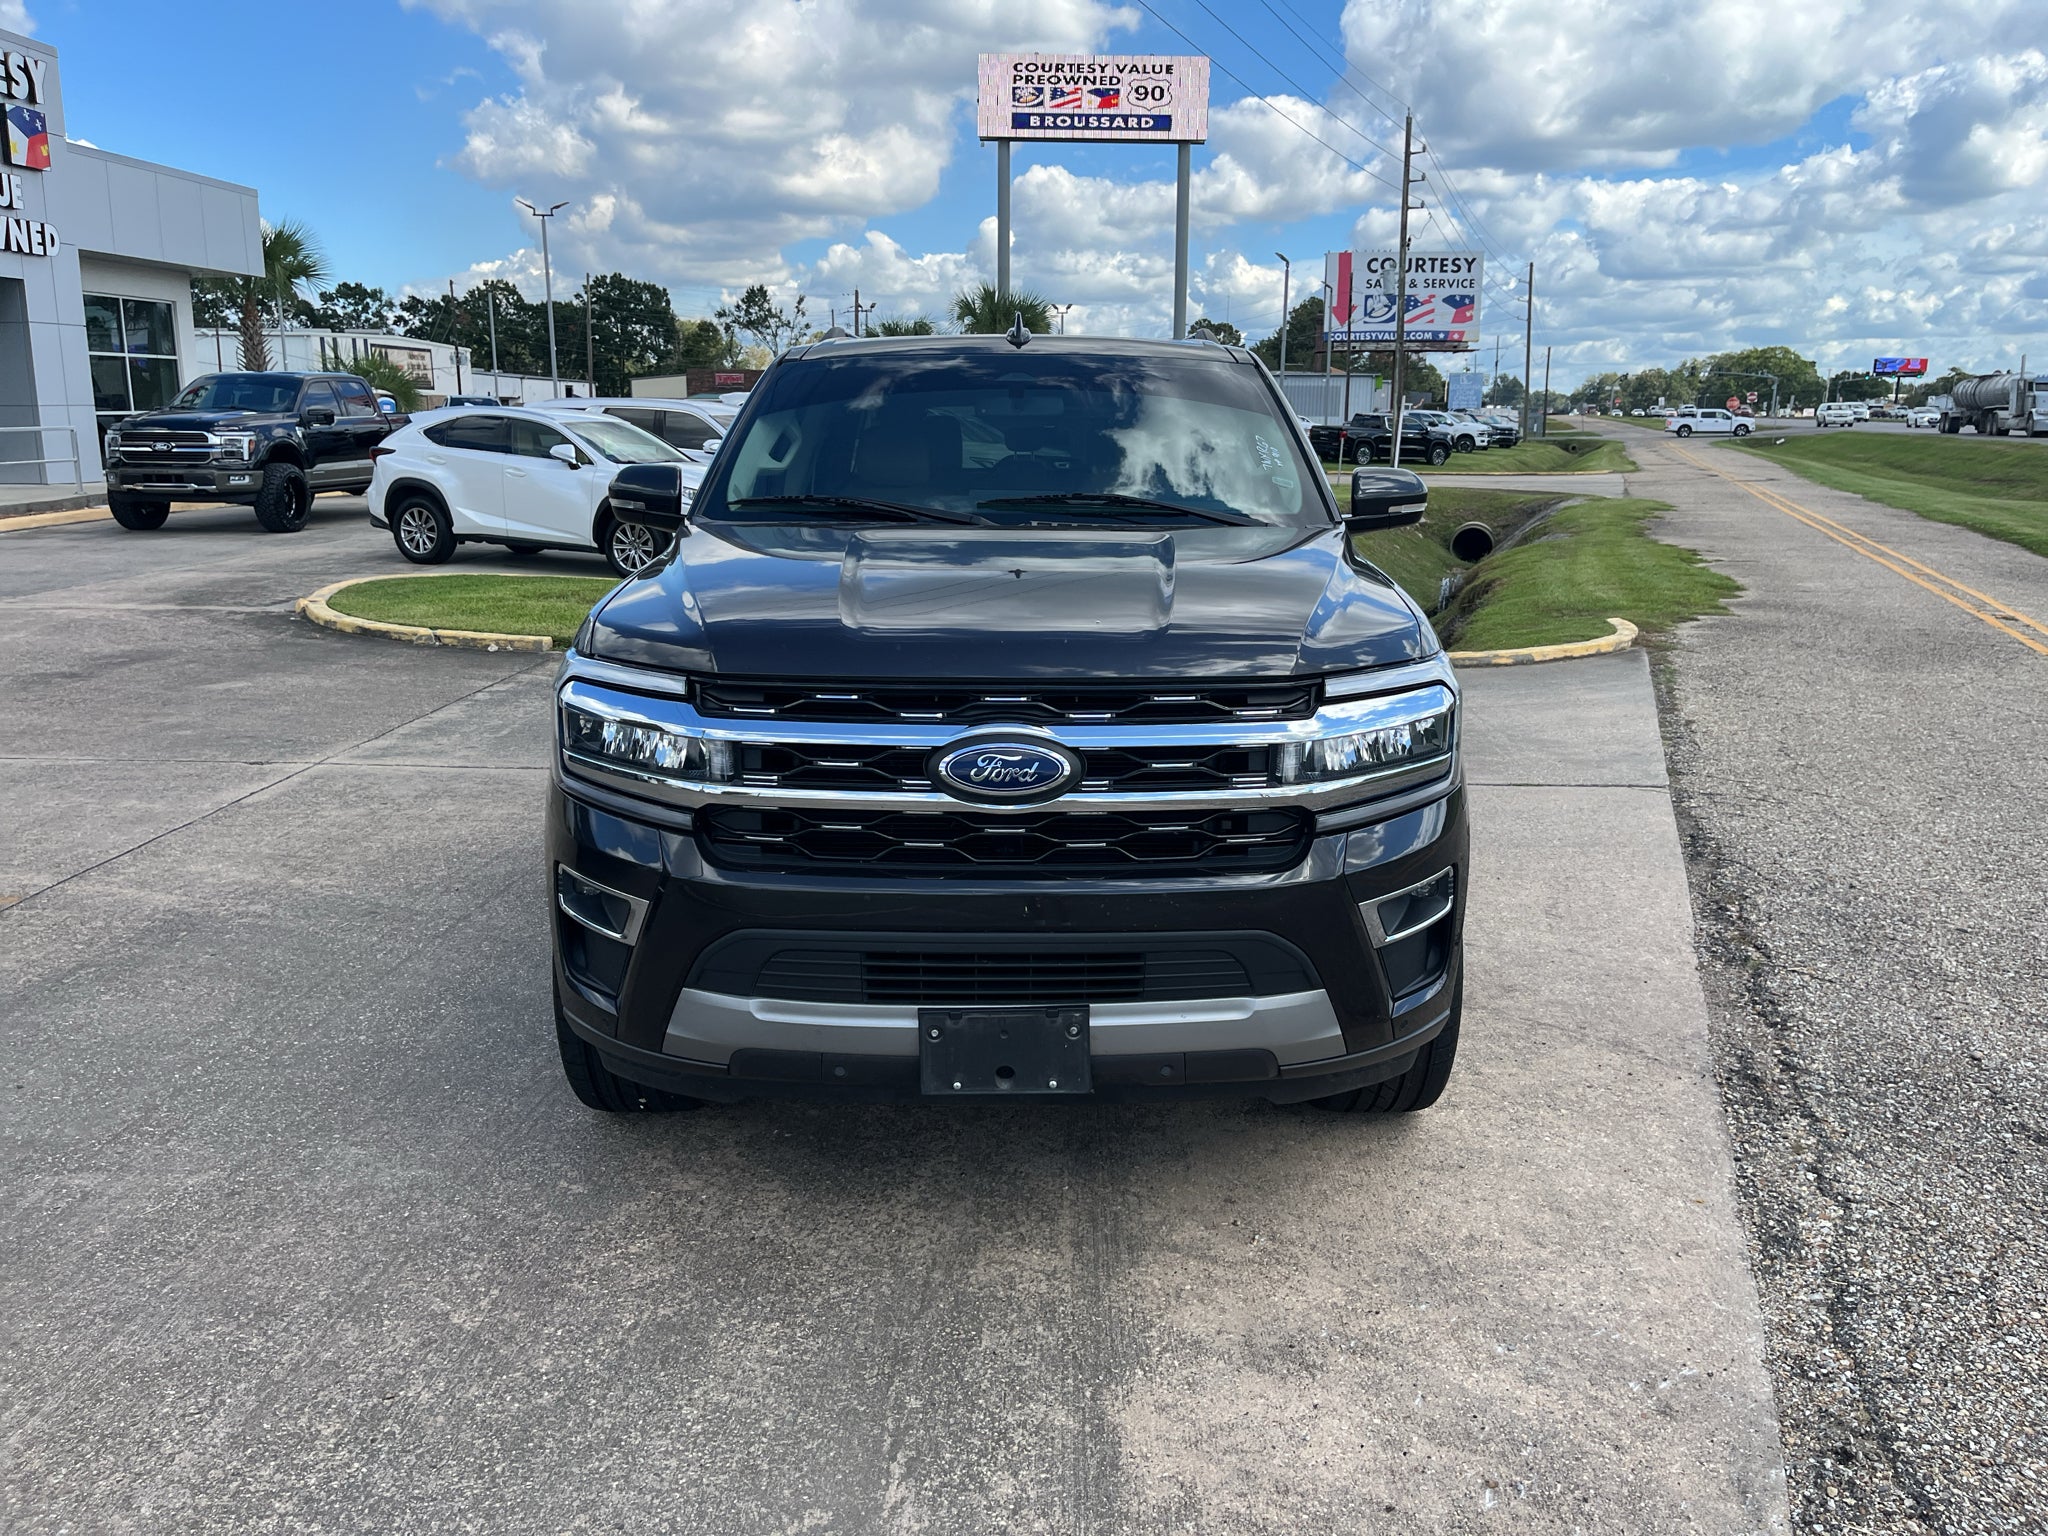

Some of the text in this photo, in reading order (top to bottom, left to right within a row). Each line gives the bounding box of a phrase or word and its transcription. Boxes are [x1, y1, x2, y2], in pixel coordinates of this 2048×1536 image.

[1013, 62, 1174, 75] COURTESY VALUE
[1013, 74, 1121, 86] PREOWNED
[1134, 85, 1165, 101] 90
[1029, 116, 1154, 129] BROUSSARD
[1408, 278, 1418, 289] &
[1423, 278, 1475, 289] SERVICE
[970, 753, 1040, 783] Ford
